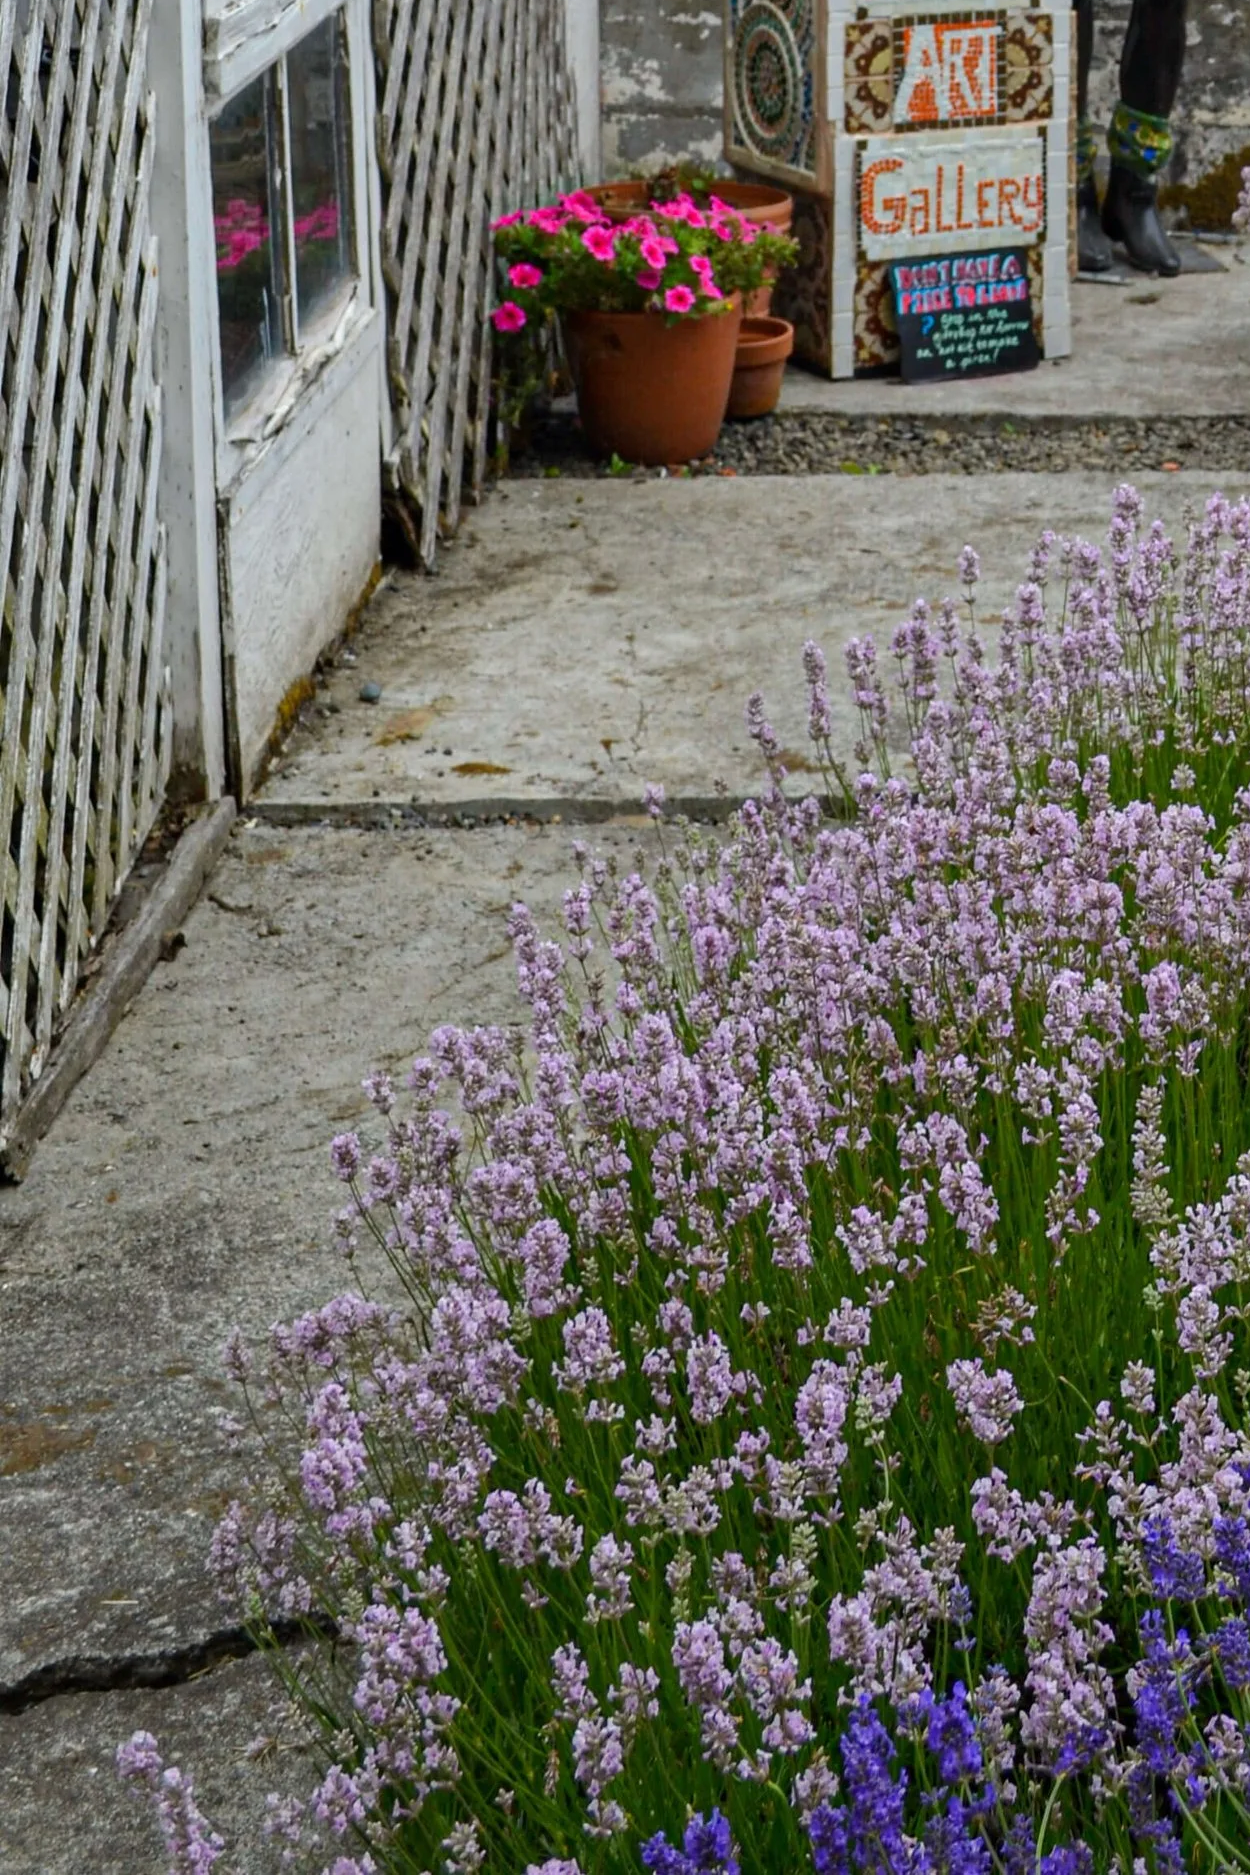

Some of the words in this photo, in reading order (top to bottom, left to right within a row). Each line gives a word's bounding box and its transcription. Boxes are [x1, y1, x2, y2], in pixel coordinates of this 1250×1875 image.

[893, 24, 1003, 123] ART
[952, 254, 1000, 285] HAVE
[1000, 255, 1022, 280] A
[897, 285, 953, 315] PIECE
[955, 284, 977, 308] TO
[976, 277, 1026, 306] LEAVE
